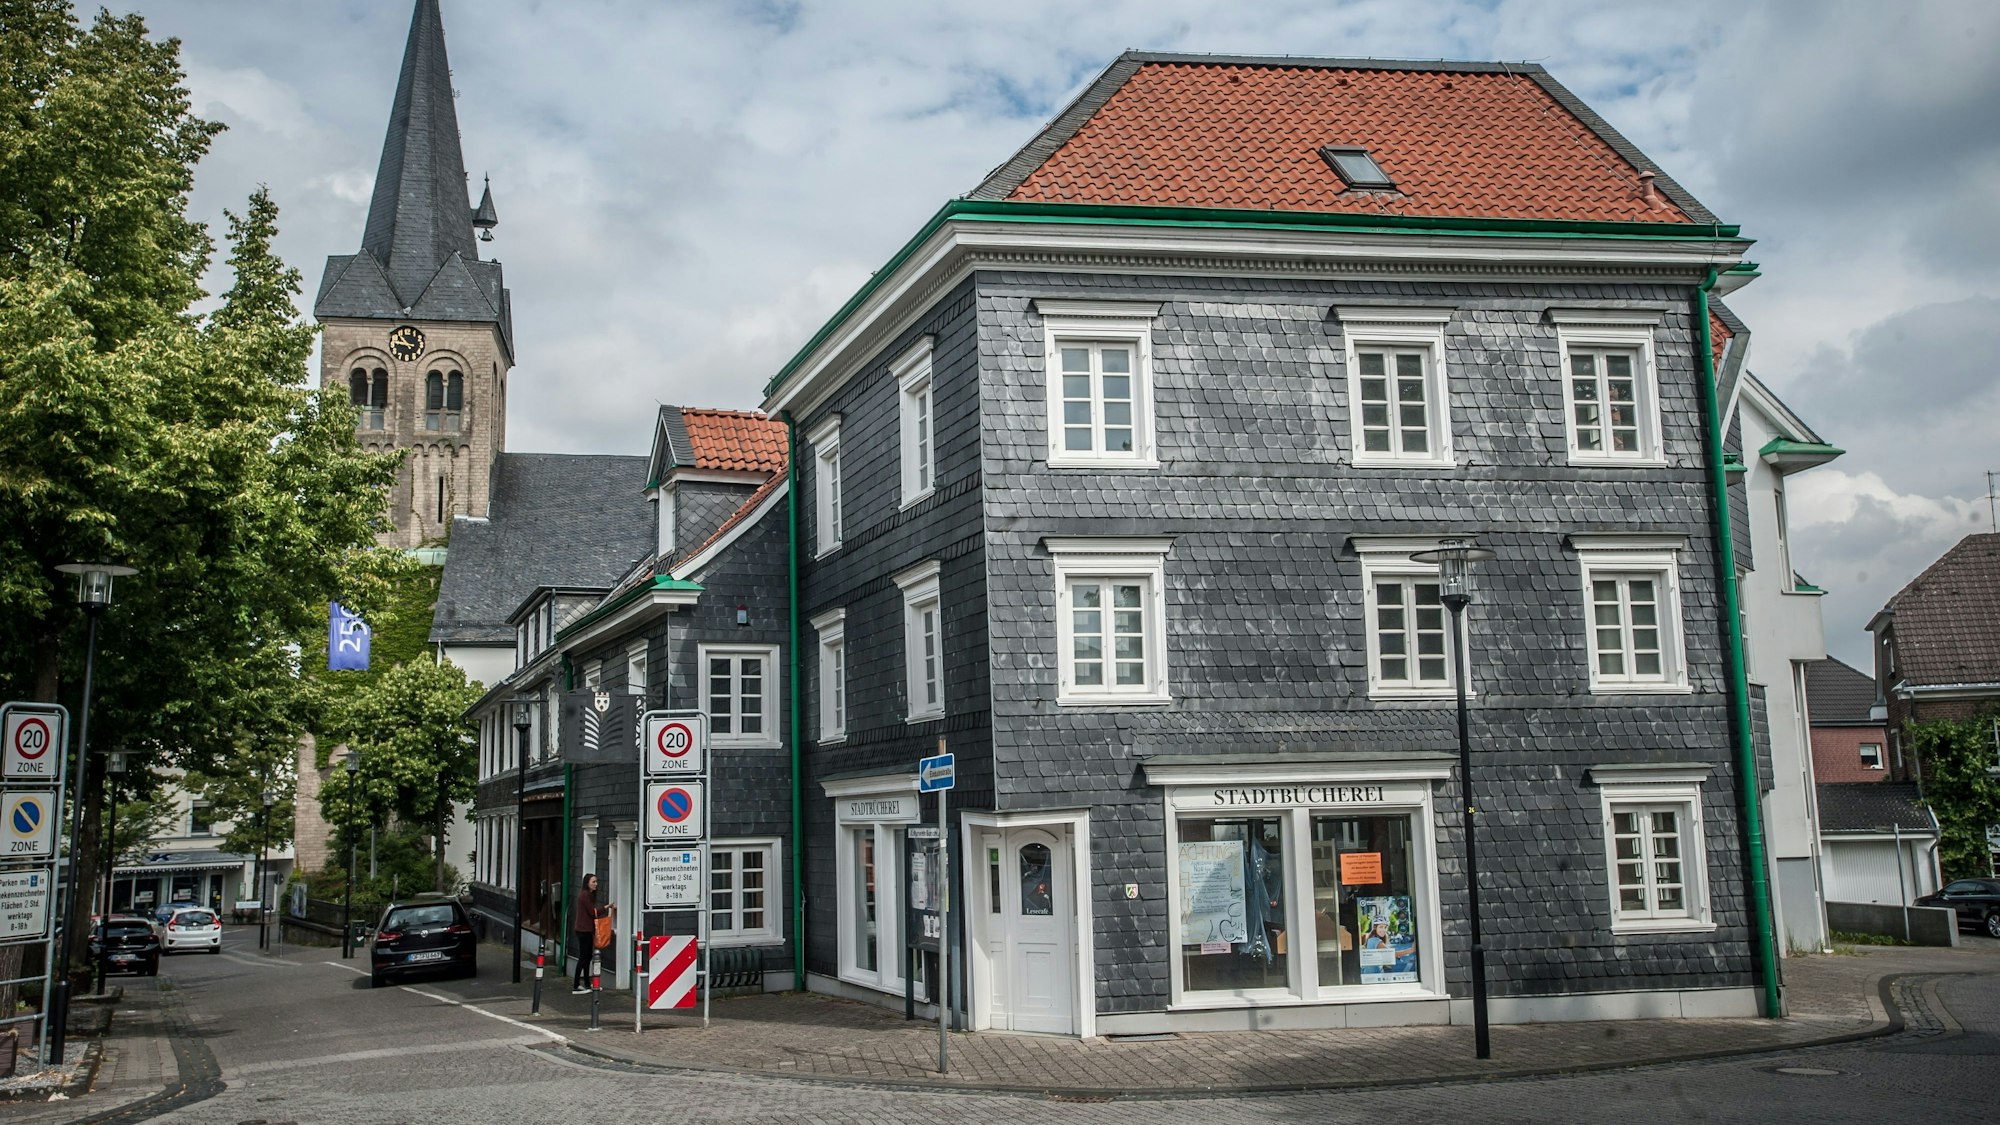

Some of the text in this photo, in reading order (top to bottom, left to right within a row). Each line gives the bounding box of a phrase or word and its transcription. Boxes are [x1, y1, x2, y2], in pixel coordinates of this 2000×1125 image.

[22, 729, 43, 748] 20
[666, 732, 685, 748] 20
[17, 762, 44, 773] ZONE
[662, 759, 688, 769] ZONE
[1214, 785, 1385, 806] STADTBÜCHEREI
[850, 800, 900, 816] STADTBÜCHEREI
[661, 825, 689, 835] ZONE
[11, 840, 39, 852] ZONE
[651, 865, 699, 874] gekennzeichneten
[662, 884, 687, 892] werktags
[0, 889, 45, 899] ekennzeichneten
[1, 901, 23, 910] Flächen
[25, 900, 29, 908] 2
[8, 912, 33, 921] werktags
